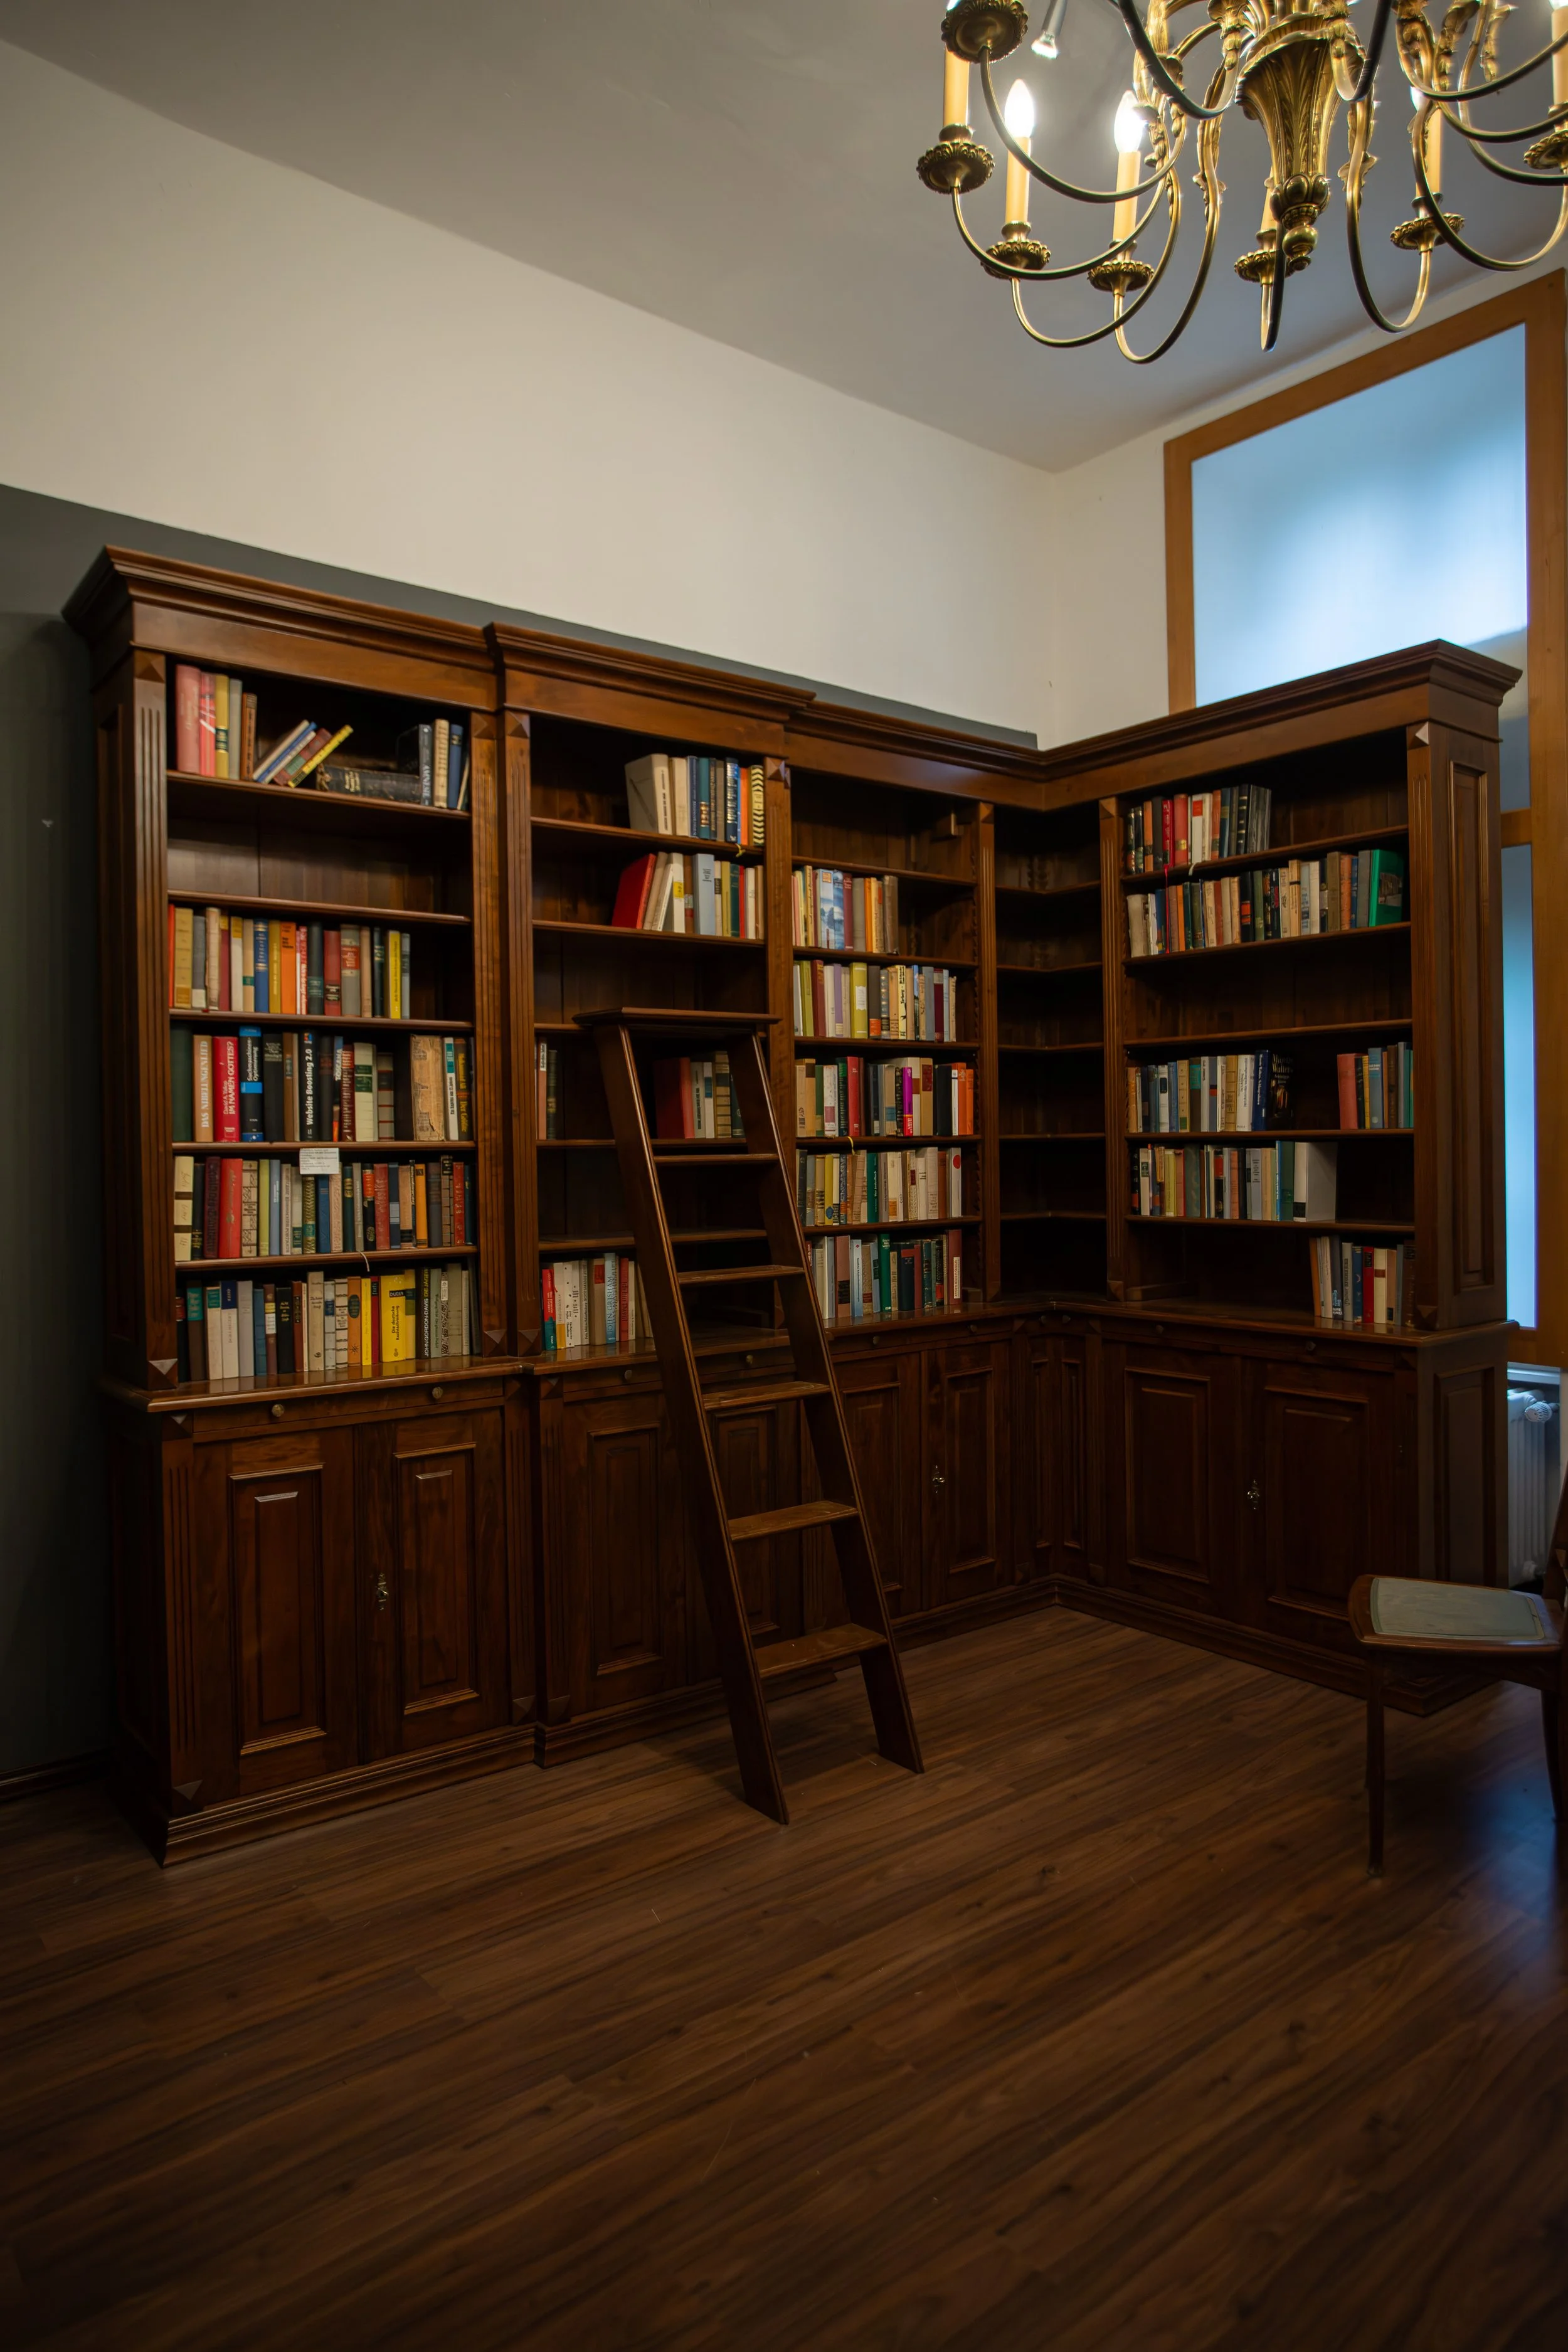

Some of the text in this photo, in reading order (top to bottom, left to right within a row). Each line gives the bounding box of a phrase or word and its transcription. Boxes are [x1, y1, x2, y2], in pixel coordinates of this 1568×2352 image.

[227, 1041, 235, 1076] GOTTES?
[200, 1041, 209, 1128] DAS NIBELUNGENLIED
[305, 1062, 314, 1095] Boosting
[229, 1105, 236, 1115] IM
